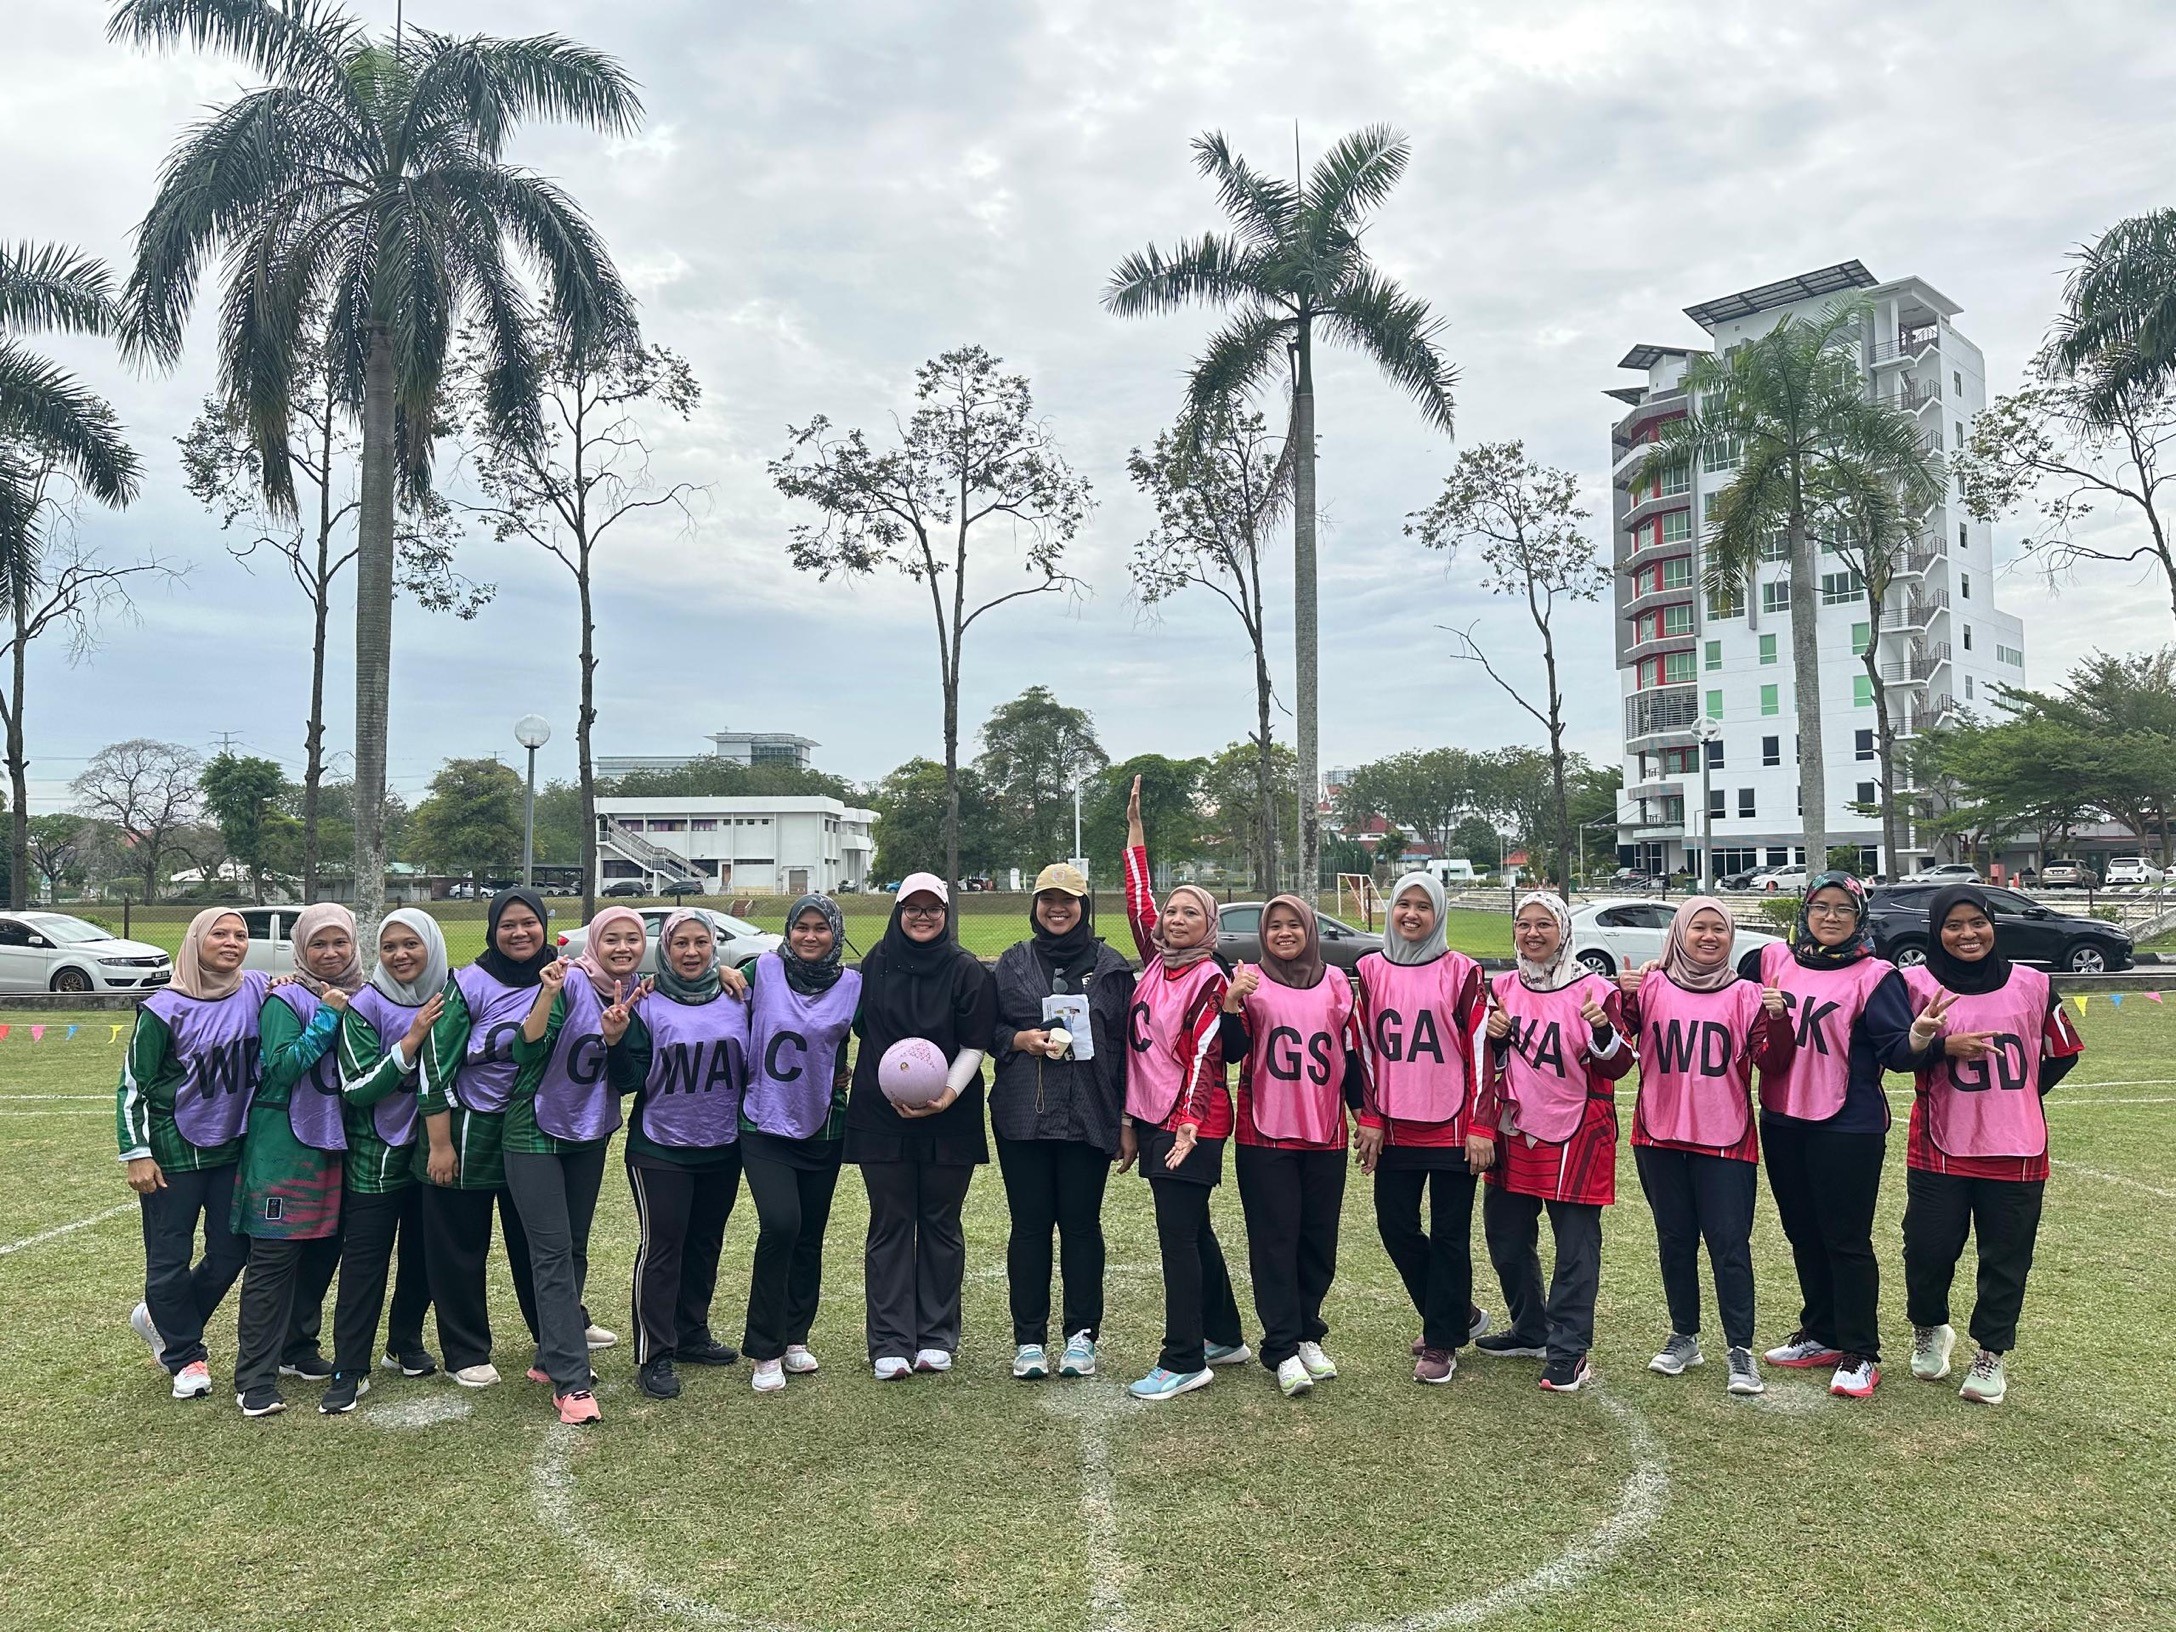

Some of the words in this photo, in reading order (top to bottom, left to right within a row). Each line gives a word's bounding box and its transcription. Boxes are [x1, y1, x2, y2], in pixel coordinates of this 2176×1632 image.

[1128, 1001, 1153, 1053] C
[1376, 1008, 1445, 1064] GA
[1653, 1020, 1731, 1077] WD
[567, 1034, 605, 1084] G
[660, 1040, 733, 1094] WA
[765, 1031, 807, 1082] C
[1267, 1026, 1332, 1086] GS
[1947, 1034, 2027, 1091] GD
